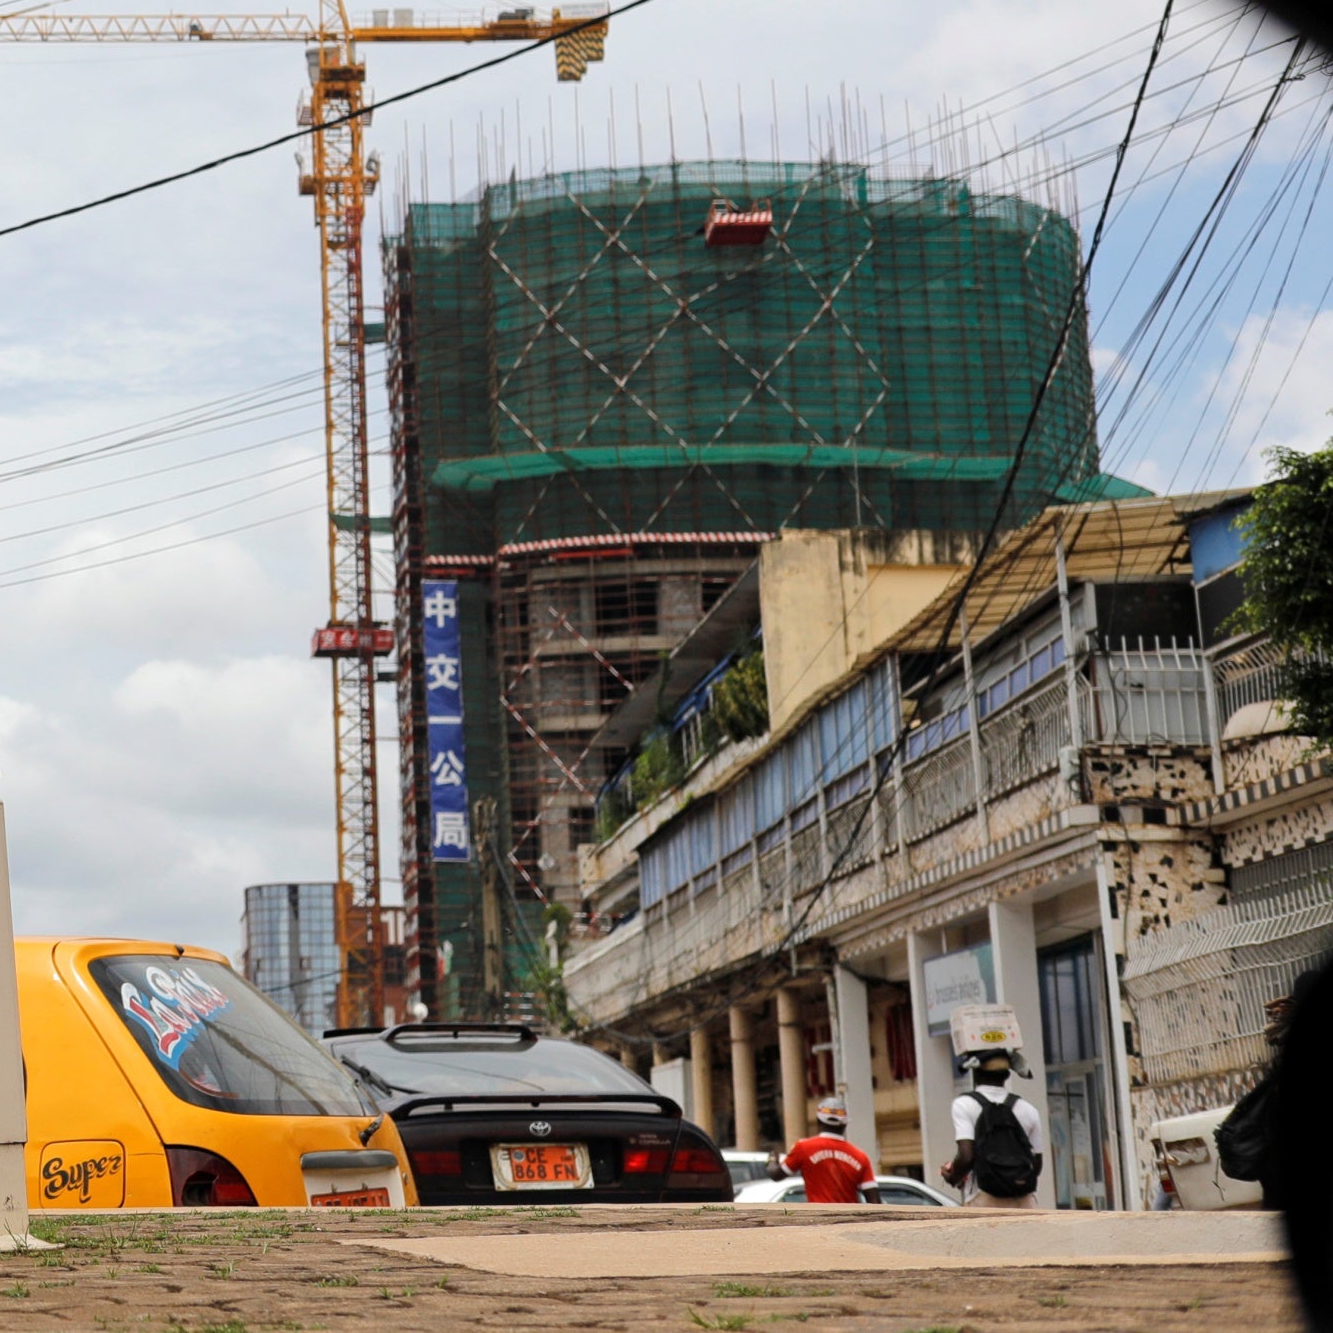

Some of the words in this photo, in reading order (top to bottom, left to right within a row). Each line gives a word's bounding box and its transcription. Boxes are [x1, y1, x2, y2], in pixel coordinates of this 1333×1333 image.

[424, 590, 468, 850] 中交一公局
[515, 1165, 547, 1180] 868
[554, 1164, 576, 1179] FN
[526, 1148, 547, 1164] CE
[42, 1156, 121, 1204] Super
